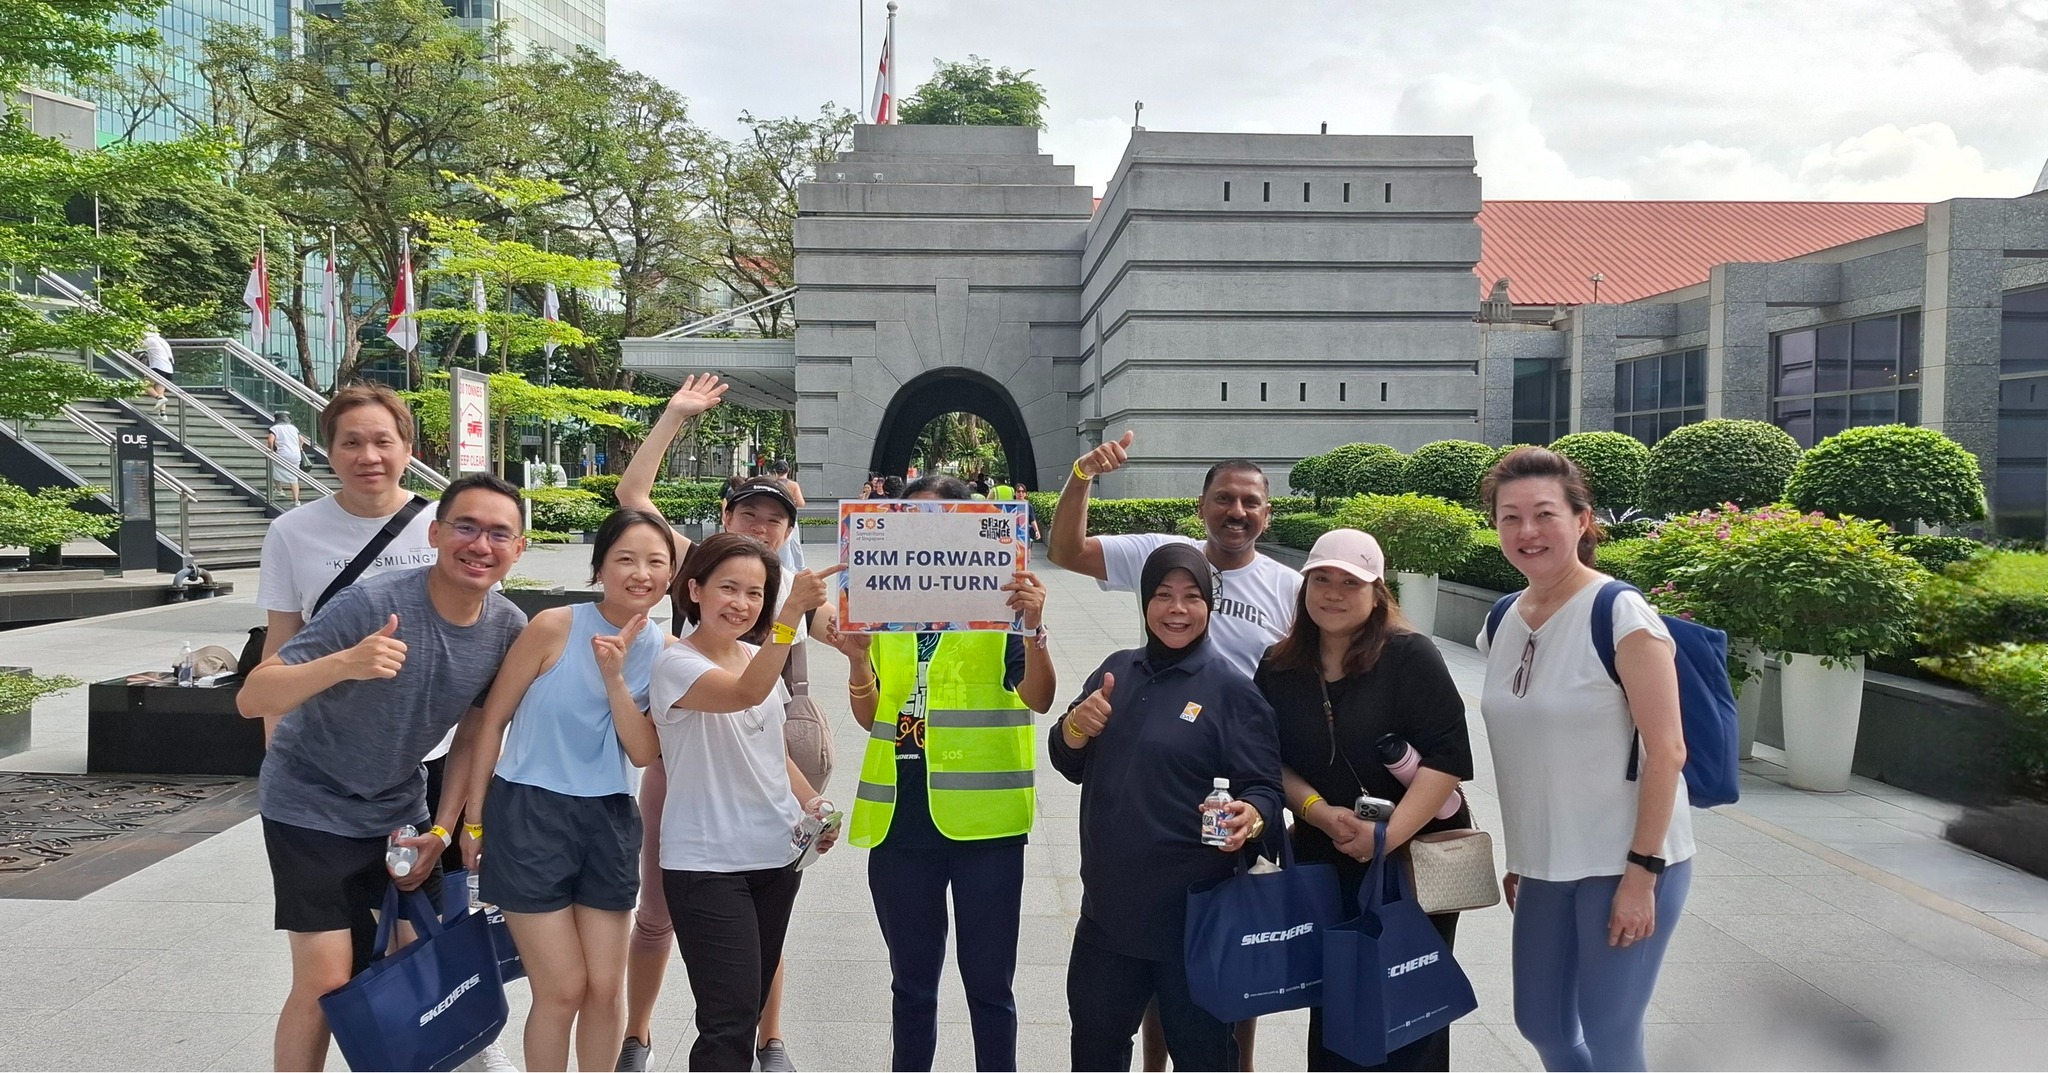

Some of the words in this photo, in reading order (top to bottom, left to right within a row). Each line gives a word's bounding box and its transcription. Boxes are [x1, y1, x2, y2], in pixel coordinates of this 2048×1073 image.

[465, 384, 482, 398] TONNES
[122, 434, 148, 444] OUE
[459, 454, 469, 466] EEP
[856, 518, 885, 529] SOS
[853, 550, 898, 566] 8KM
[905, 550, 1012, 567] FORWARD
[865, 575, 911, 591] 4KM
[919, 575, 998, 591] U-TURN
[1241, 922, 1314, 946] SKECHERS
[419, 973, 480, 1027] SKECHERS
